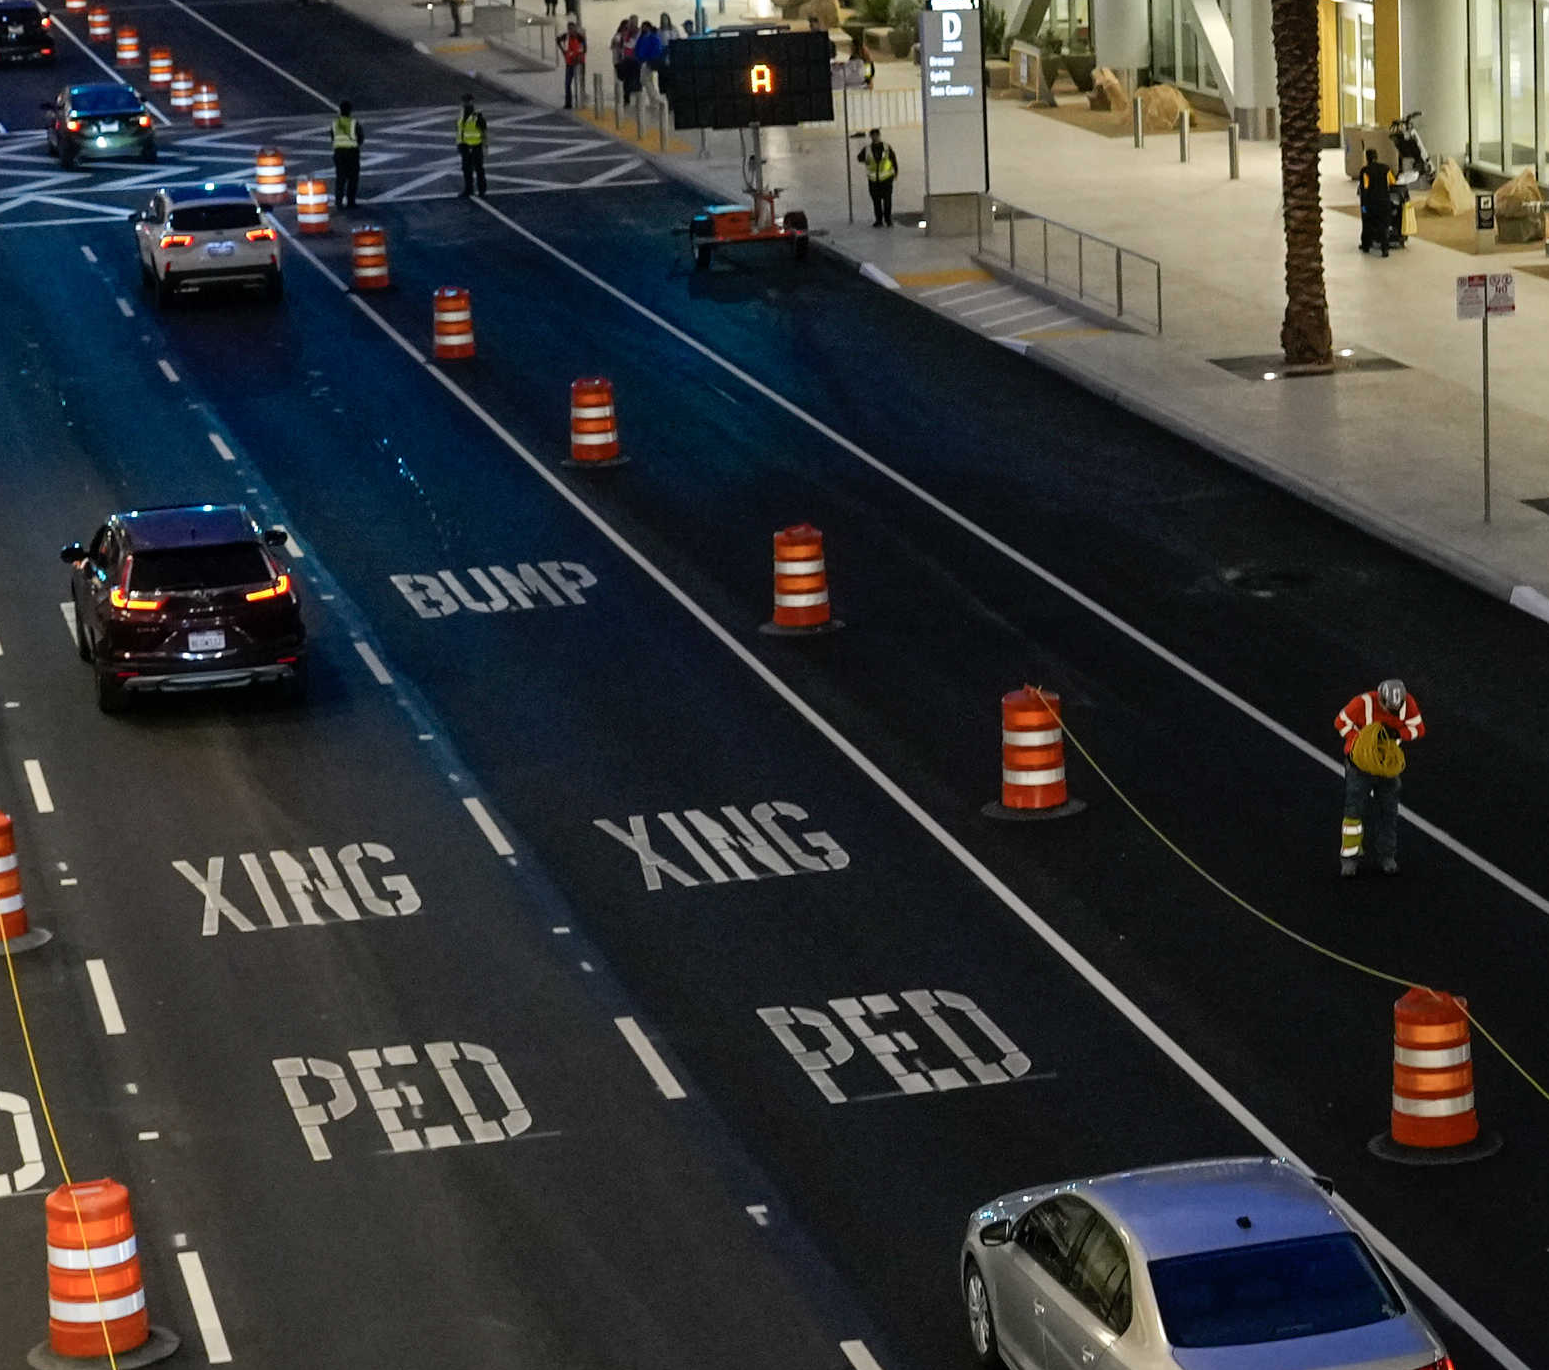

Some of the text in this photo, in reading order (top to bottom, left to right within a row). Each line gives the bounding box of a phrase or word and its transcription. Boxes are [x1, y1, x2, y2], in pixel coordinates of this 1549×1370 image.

[942, 12, 962, 40] D
[750, 64, 771, 94] A
[390, 562, 597, 618] BUMP
[172, 843, 421, 936] XING
[593, 802, 849, 890] XING
[756, 990, 1031, 1103] PED
[273, 1042, 532, 1161] PED
